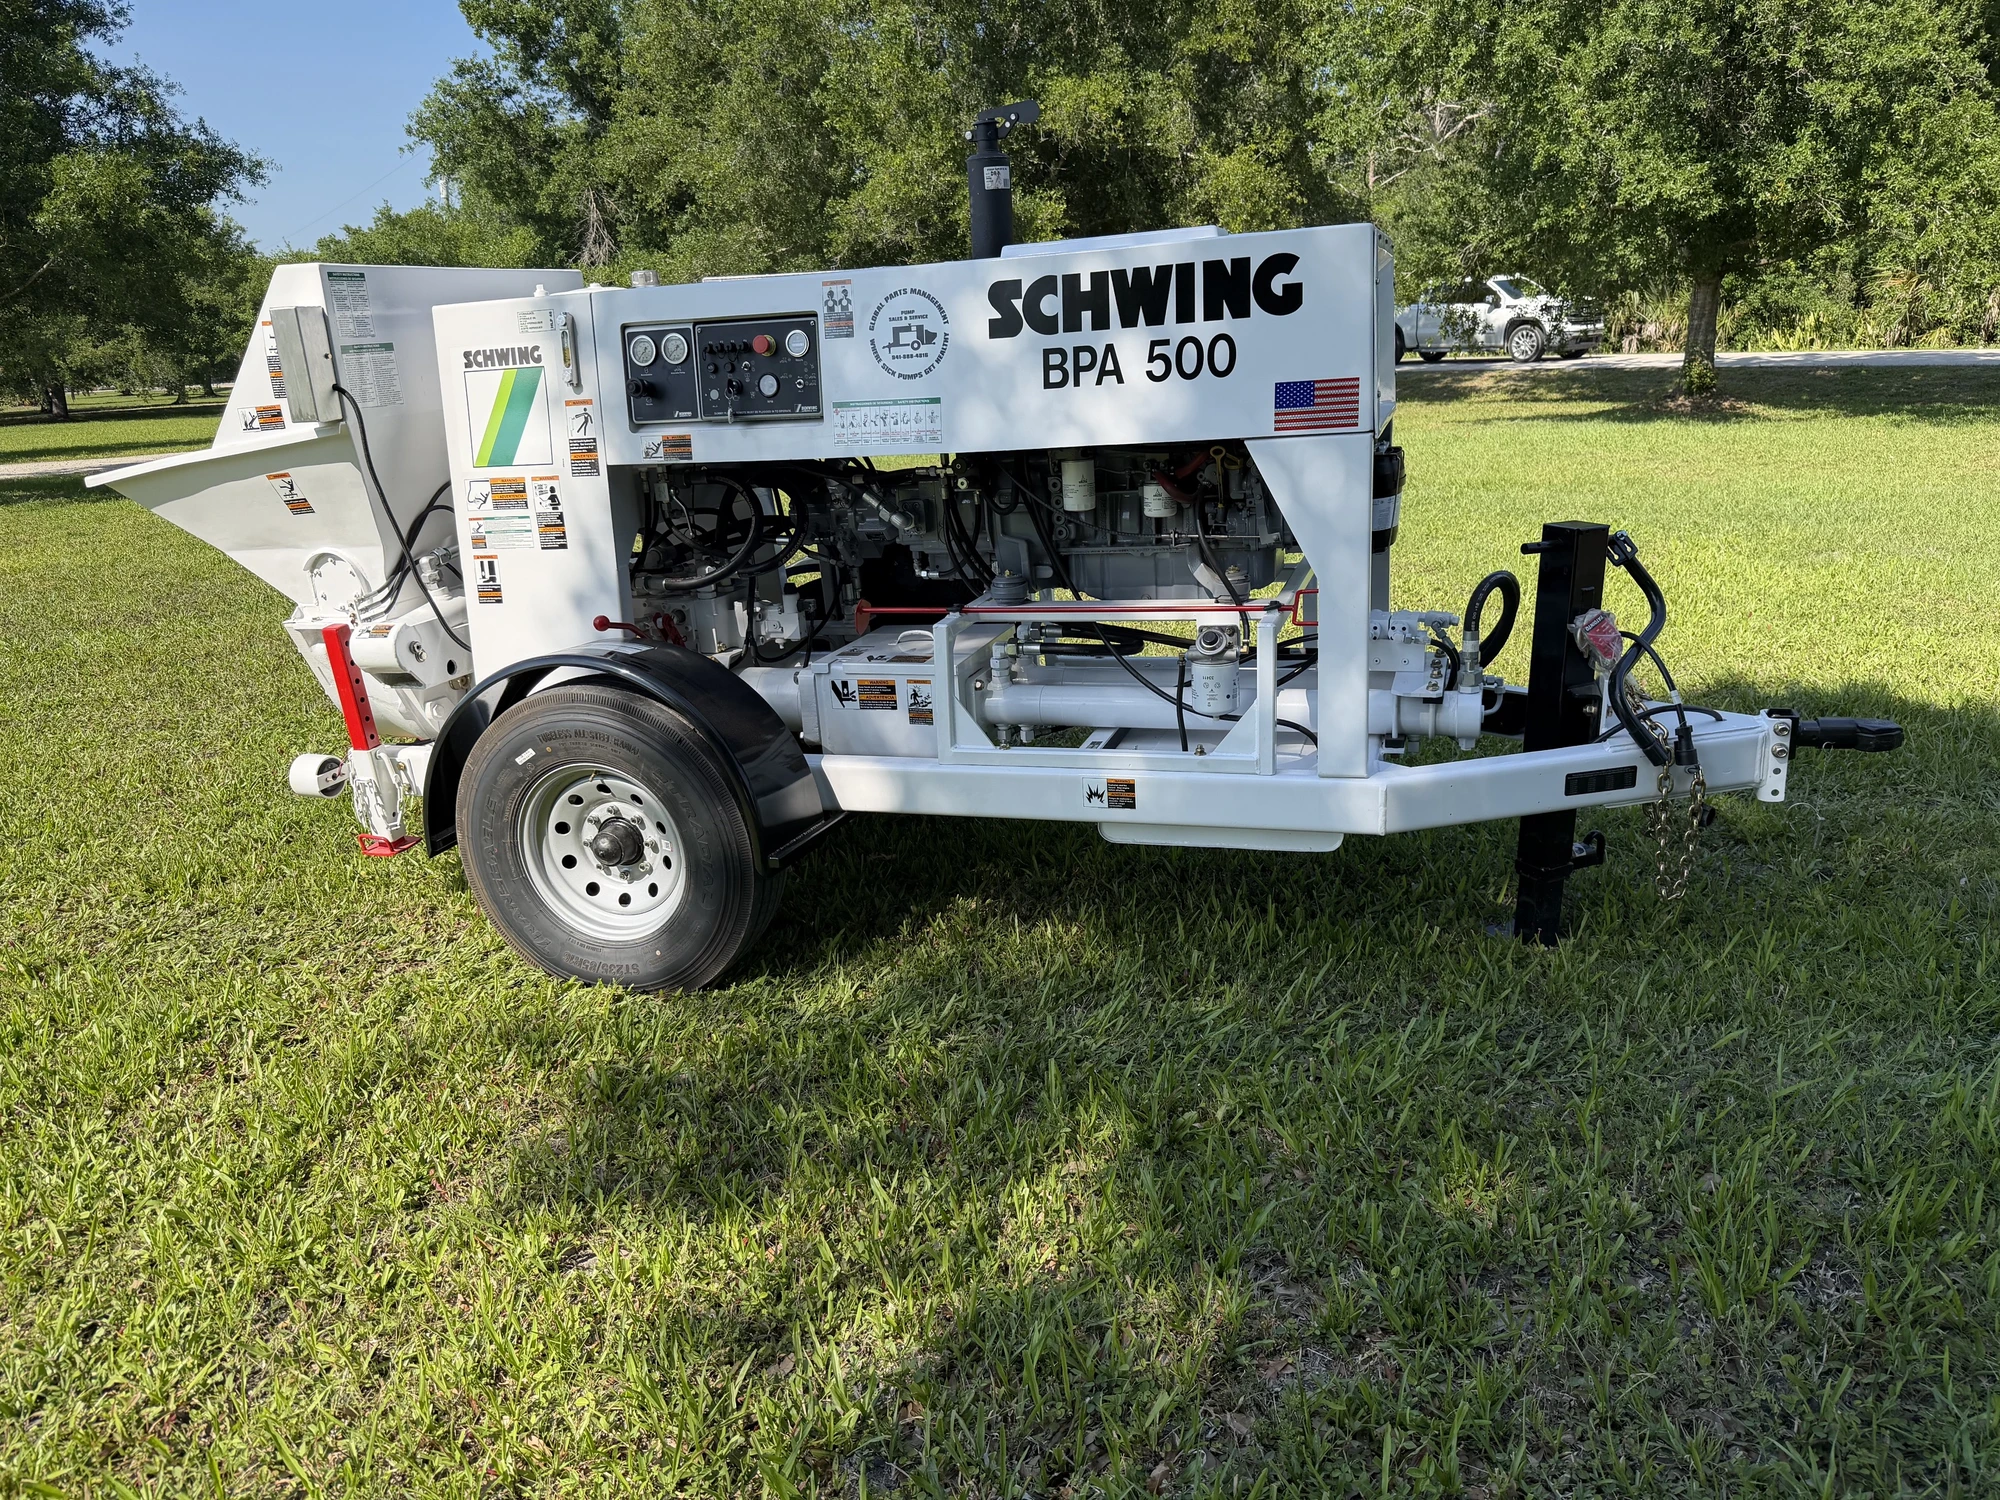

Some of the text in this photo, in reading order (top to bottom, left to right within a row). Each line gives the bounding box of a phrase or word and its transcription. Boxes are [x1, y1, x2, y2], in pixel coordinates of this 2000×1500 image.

[868, 302, 885, 332] GLOBAL
[884, 287, 908, 303] PARTS
[909, 287, 950, 325] MANAGEMENT
[988, 252, 1303, 339] SCHWING
[463, 345, 542, 369] SCHWING
[869, 332, 950, 381] WHERE SICK PUMPS GET HEALTHY
[1042, 333, 1237, 390] BPA 500
